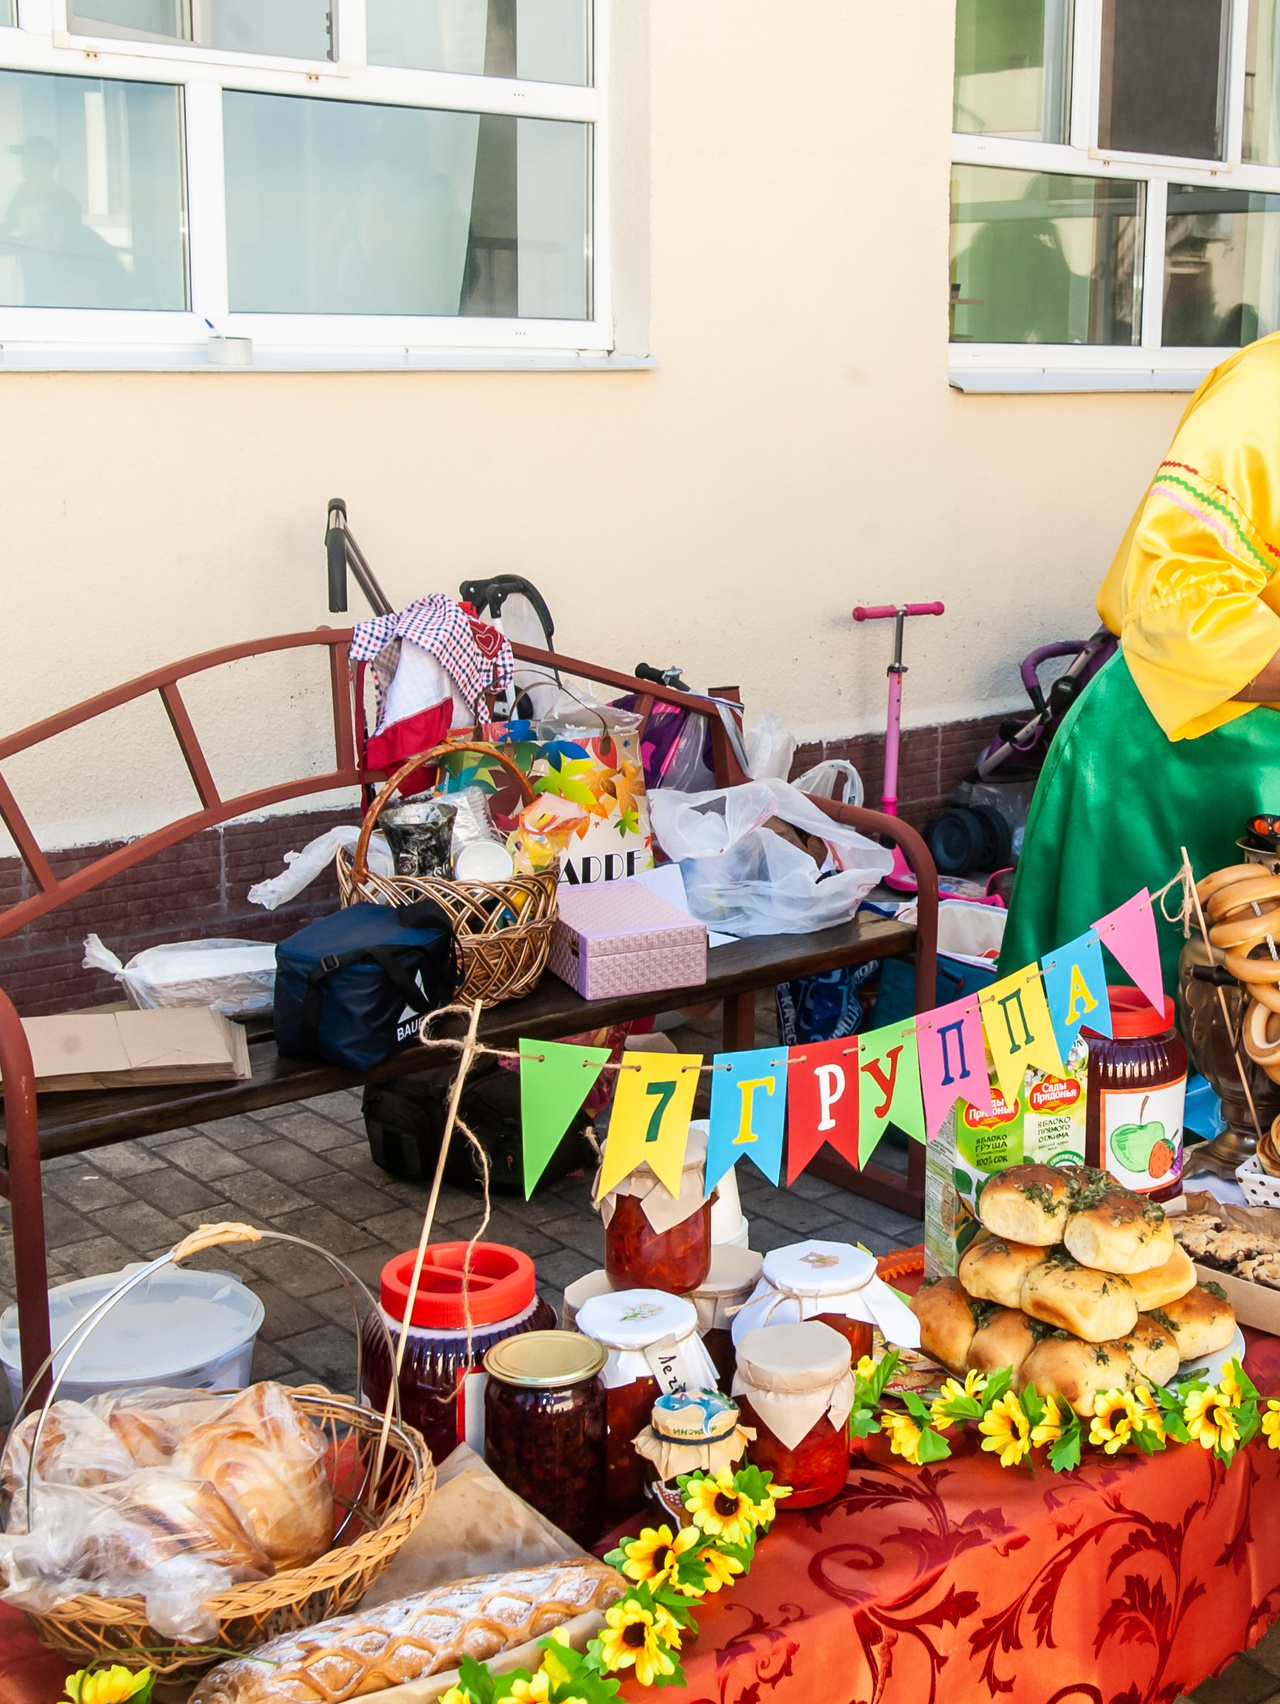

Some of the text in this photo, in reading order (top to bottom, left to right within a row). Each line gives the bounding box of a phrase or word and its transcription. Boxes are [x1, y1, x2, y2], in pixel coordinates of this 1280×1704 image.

[780, 995, 798, 1045] КАЧЕС
[645, 1080, 677, 1143] 7
[733, 964, 1098, 1144] ГРУППА
[1042, 1082, 1067, 1094] Сады
[1033, 1089, 1077, 1105] Придонья
[1037, 1116, 1071, 1129] ЯБЛОКО
[975, 1134, 1008, 1145] ЯБЛОКО
[1038, 1132, 1069, 1143] ОТЖИМА
[975, 1141, 1008, 1153] ГРУША
